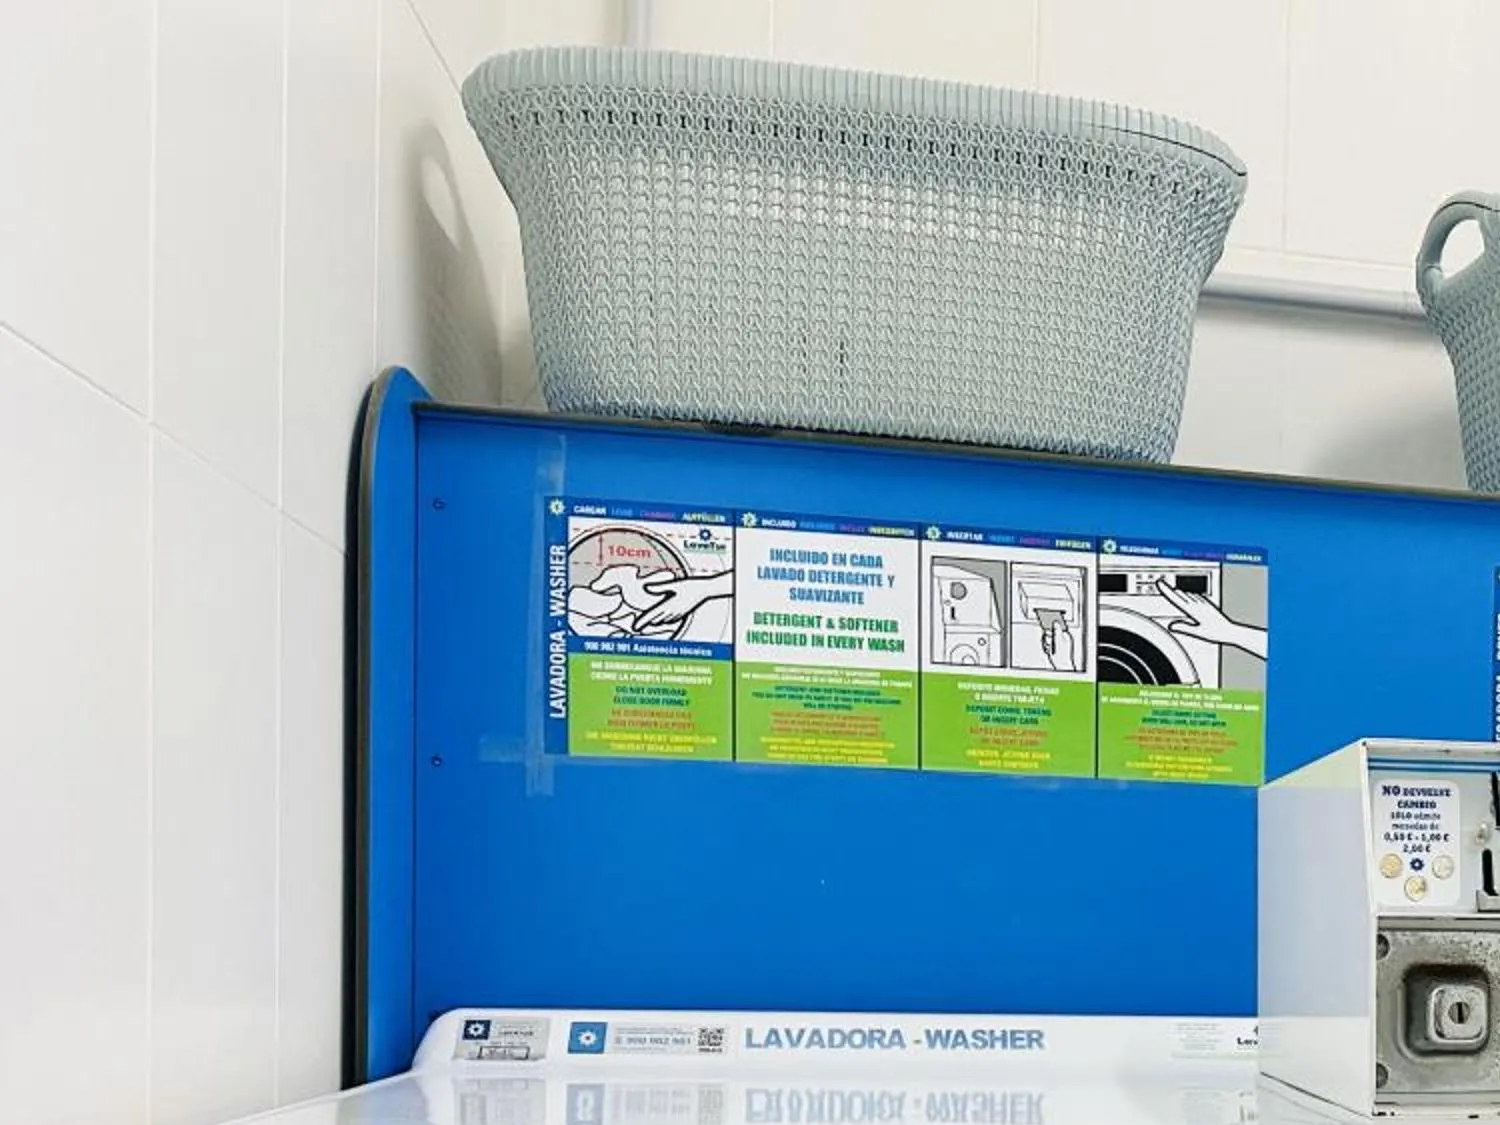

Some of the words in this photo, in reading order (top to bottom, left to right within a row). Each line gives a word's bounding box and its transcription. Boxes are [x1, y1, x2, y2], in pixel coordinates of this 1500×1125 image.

[607, 544, 651, 559] 10cm
[769, 547, 829, 566] INCLUIDO
[832, 552, 848, 567] EN
[850, 553, 883, 569] CADA
[550, 544, 567, 617] WASHER
[757, 566, 805, 583] LAVADO
[808, 569, 883, 588] DETERGENTE
[887, 575, 896, 588] Y
[788, 587, 865, 606] SUAVIZANTE
[752, 611, 822, 630] DETERGENT
[826, 617, 835, 630] &
[838, 616, 899, 634] SOFTENER
[746, 629, 807, 647] INCLUDED
[811, 633, 825, 647] IN
[827, 635, 865, 650] EVERY
[867, 637, 905, 653] WASH
[550, 630, 567, 719] LAVADORA
[1381, 785, 1401, 797] NO
[744, 1028, 906, 1050] LAVADORA
[925, 1029, 1046, 1051] WASHER
